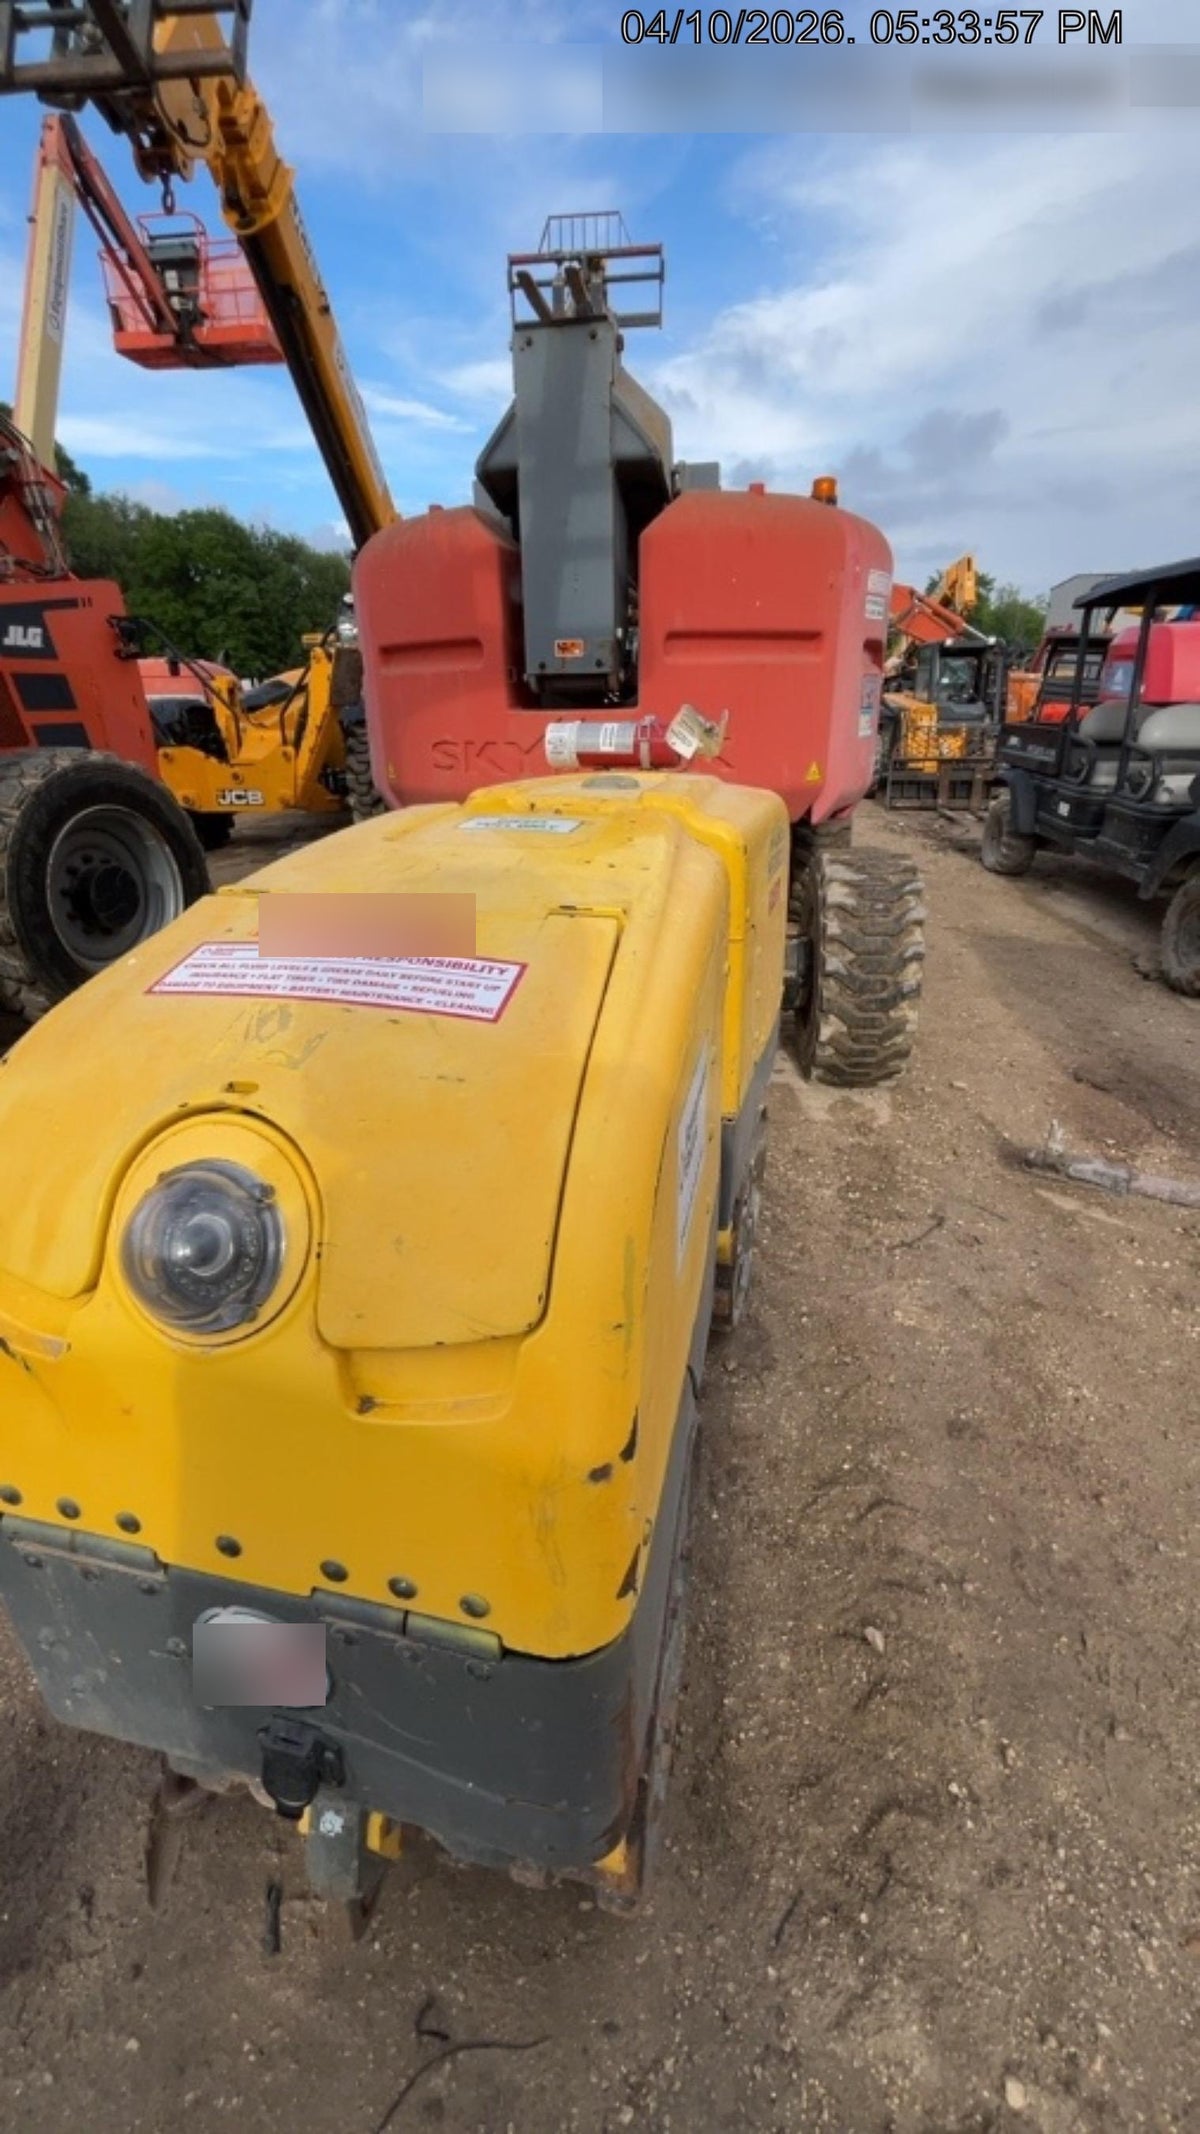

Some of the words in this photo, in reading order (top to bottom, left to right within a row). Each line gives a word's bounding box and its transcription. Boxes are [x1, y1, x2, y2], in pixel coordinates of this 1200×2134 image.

[3, 625, 43, 648] JLG
[217, 788, 265, 806] JCB
[239, 963, 269, 972] FLUID
[365, 969, 396, 980] DAILY
[399, 973, 444, 986] BEFORE
[445, 979, 481, 990] START
[483, 983, 503, 993] UP
[254, 972, 284, 981] FLAT
[352, 979, 401, 991] DAMAGE
[411, 986, 475, 999] REFUELING
[288, 985, 338, 996] BATTERY
[340, 989, 424, 1003] MAINTENANCE
[434, 1001, 495, 1014] CLEANING
